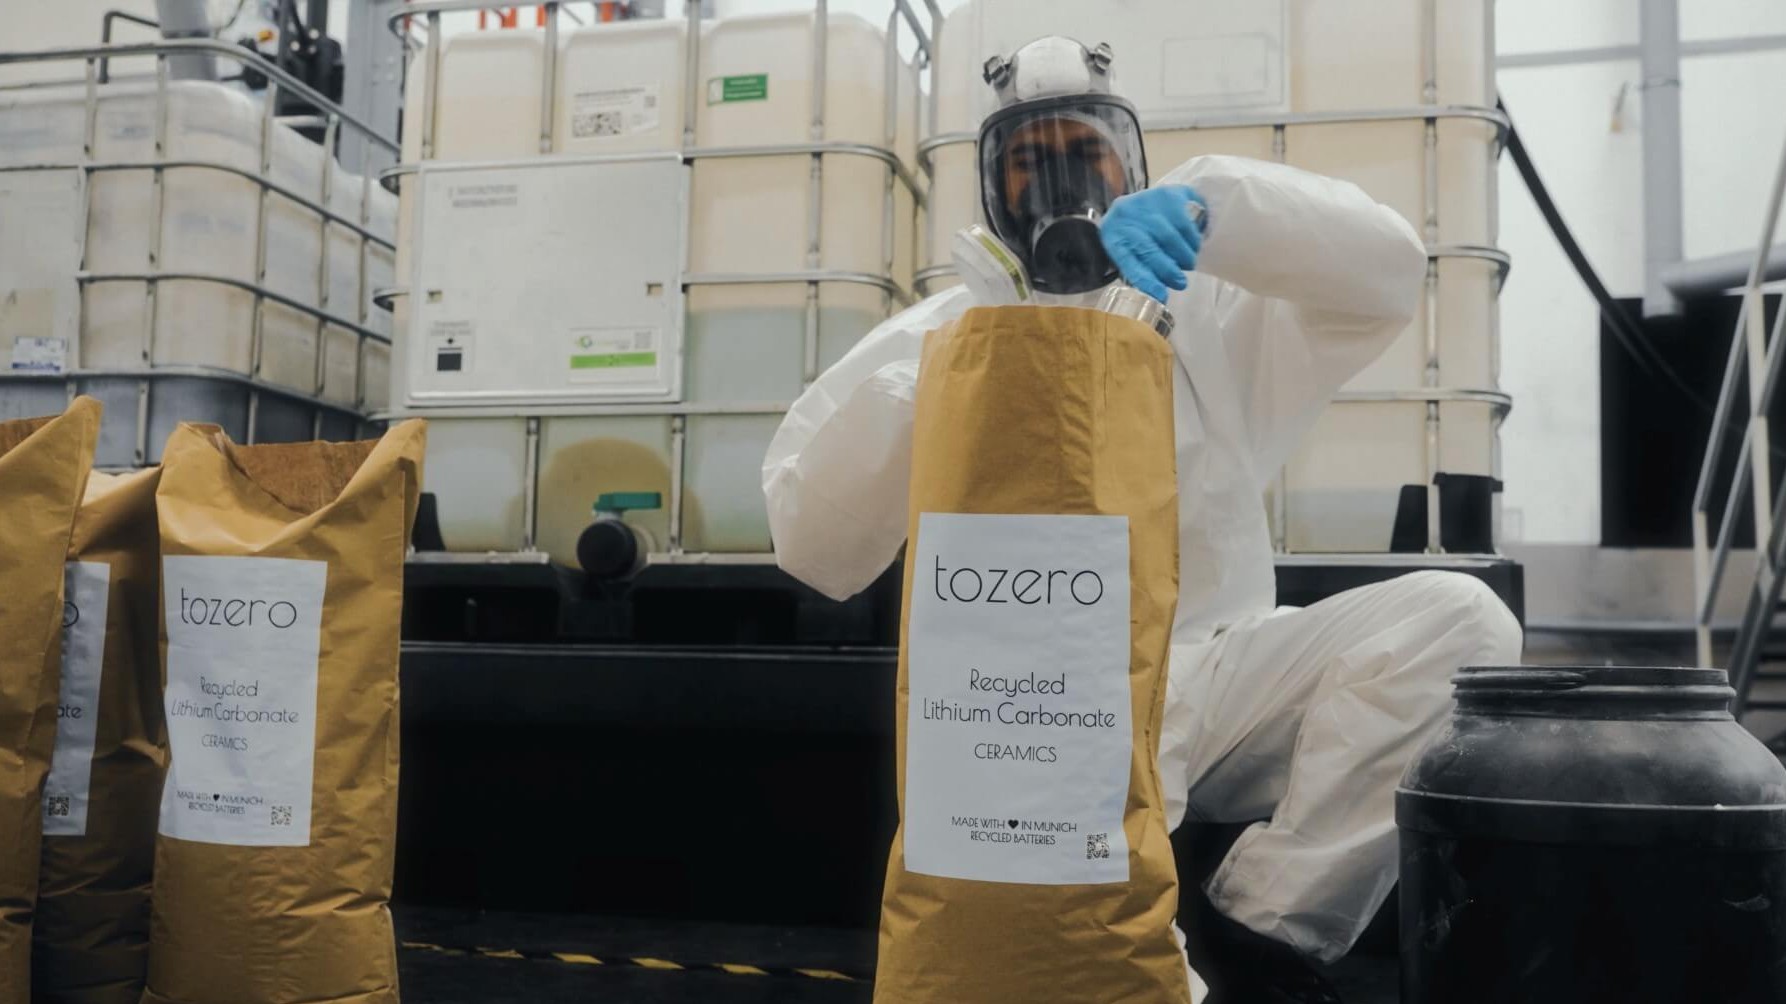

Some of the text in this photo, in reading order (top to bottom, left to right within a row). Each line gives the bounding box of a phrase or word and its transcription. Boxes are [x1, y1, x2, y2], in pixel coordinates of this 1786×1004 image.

[935, 555, 1103, 606] tozero
[180, 587, 297, 629] tozero
[200, 676, 258, 699] Recycled
[970, 668, 1065, 698] Recycled
[171, 699, 299, 723] Lithium Carbonate
[923, 697, 1116, 728] Lithium Carbonate
[201, 734, 249, 751] CERAMICS
[974, 743, 1057, 763] CERAMICS
[951, 816, 1077, 833] MADE WITH IN MUNICH
[970, 830, 1056, 846] RECYCLED BATTERIES
